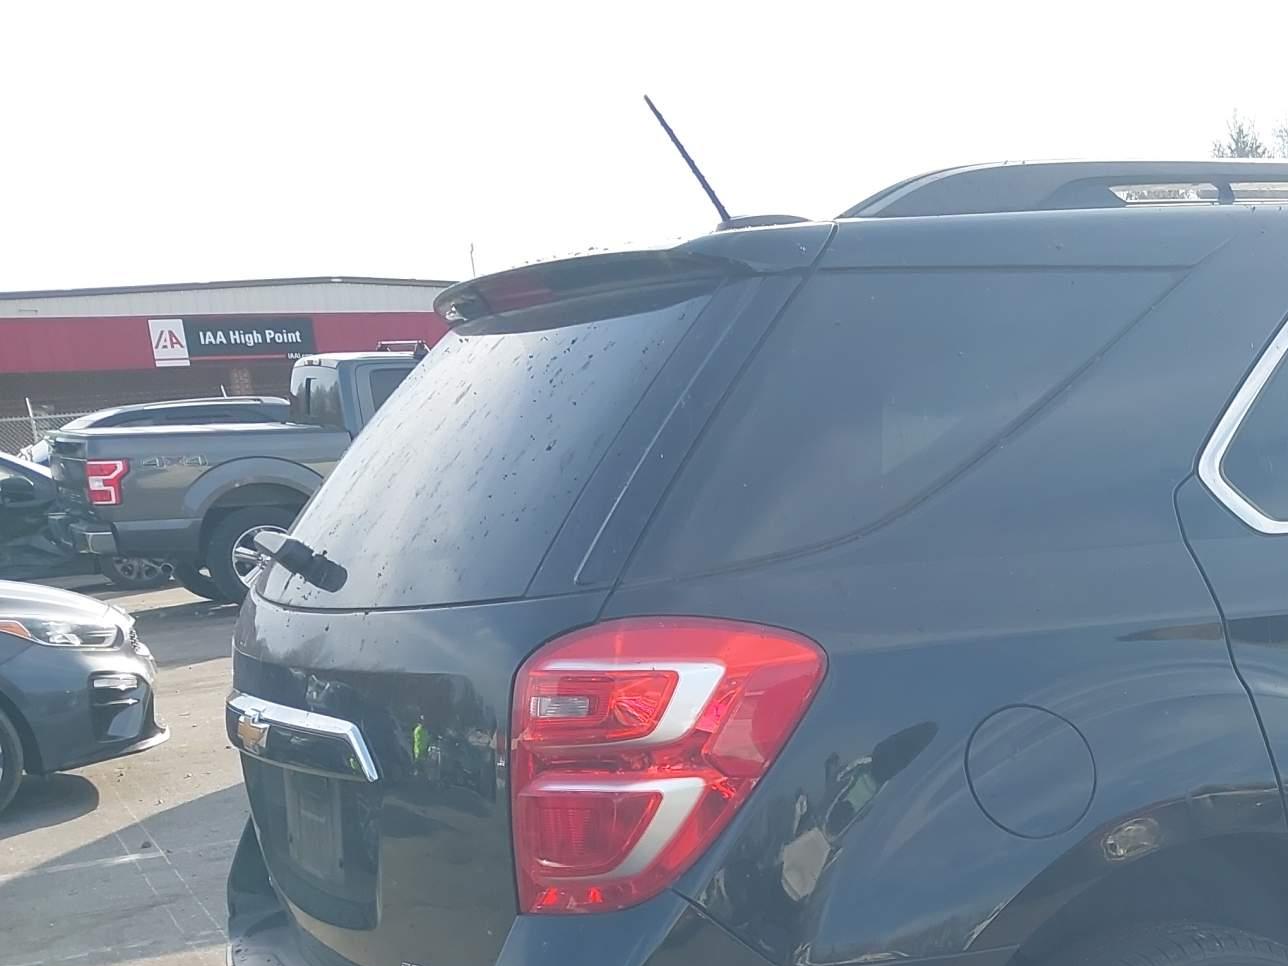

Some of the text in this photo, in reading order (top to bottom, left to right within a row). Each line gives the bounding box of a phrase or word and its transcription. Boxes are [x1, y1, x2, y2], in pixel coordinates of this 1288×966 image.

[199, 329, 302, 347] IAA High Point
